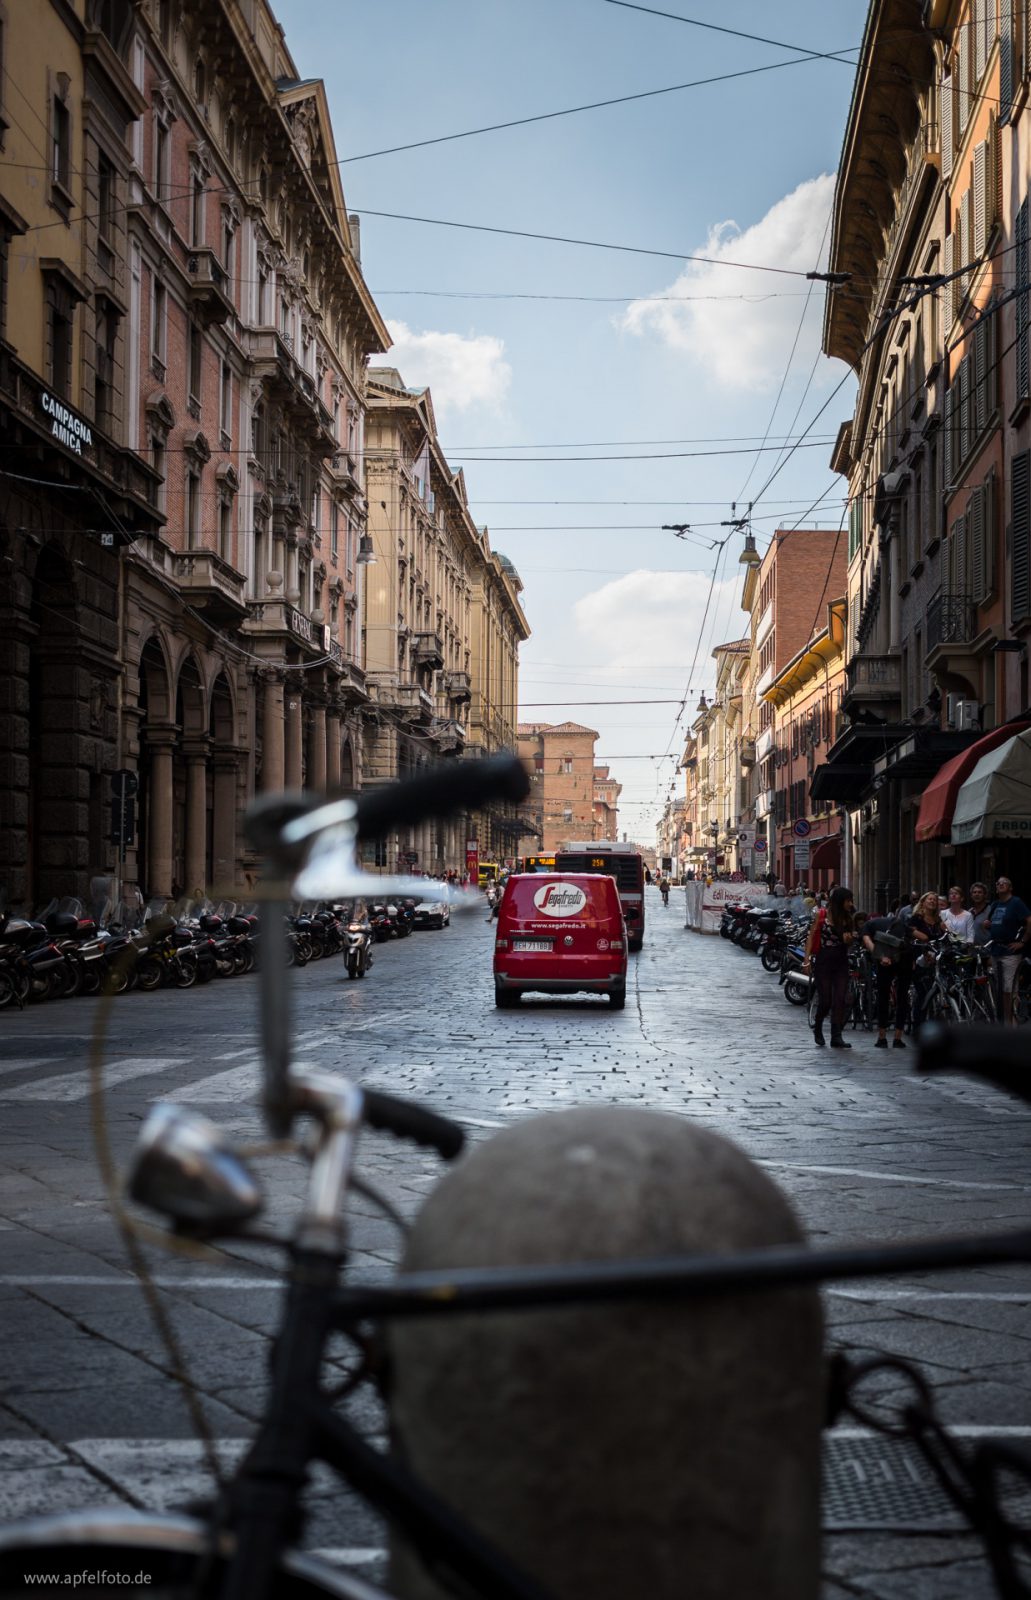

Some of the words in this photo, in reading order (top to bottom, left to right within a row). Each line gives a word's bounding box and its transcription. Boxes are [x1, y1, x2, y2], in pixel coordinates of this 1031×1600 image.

[42, 392, 92, 446] CAMPAGNA
[52, 421, 82, 456] AMICA
[994, 820, 1031, 831] ERBO
[538, 886, 583, 909] Segafredo
[531, 922, 586, 930] www.segafredo.it
